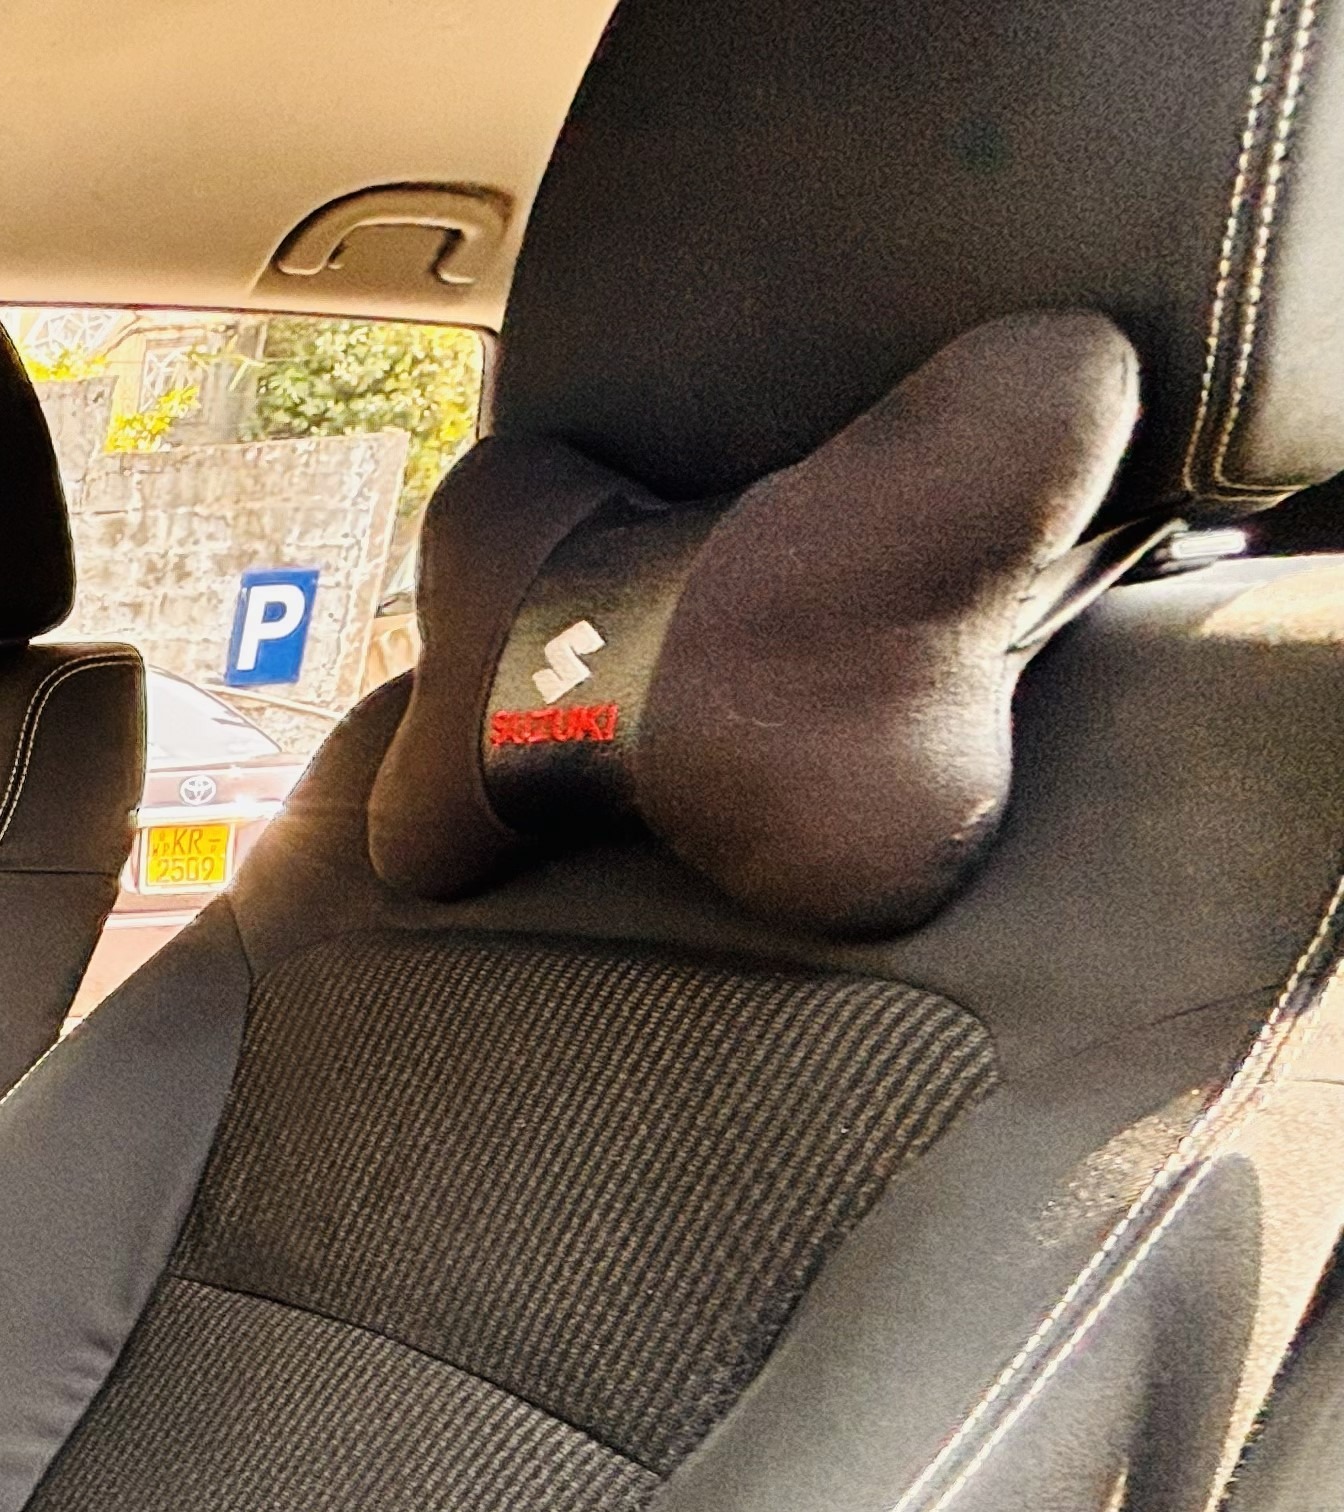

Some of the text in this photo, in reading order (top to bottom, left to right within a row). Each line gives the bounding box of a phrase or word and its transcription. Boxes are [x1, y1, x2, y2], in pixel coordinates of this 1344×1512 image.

[236, 584, 305, 671] P
[491, 704, 618, 746] SUZUKI
[172, 828, 204, 855] KR
[156, 857, 215, 882] 2509
